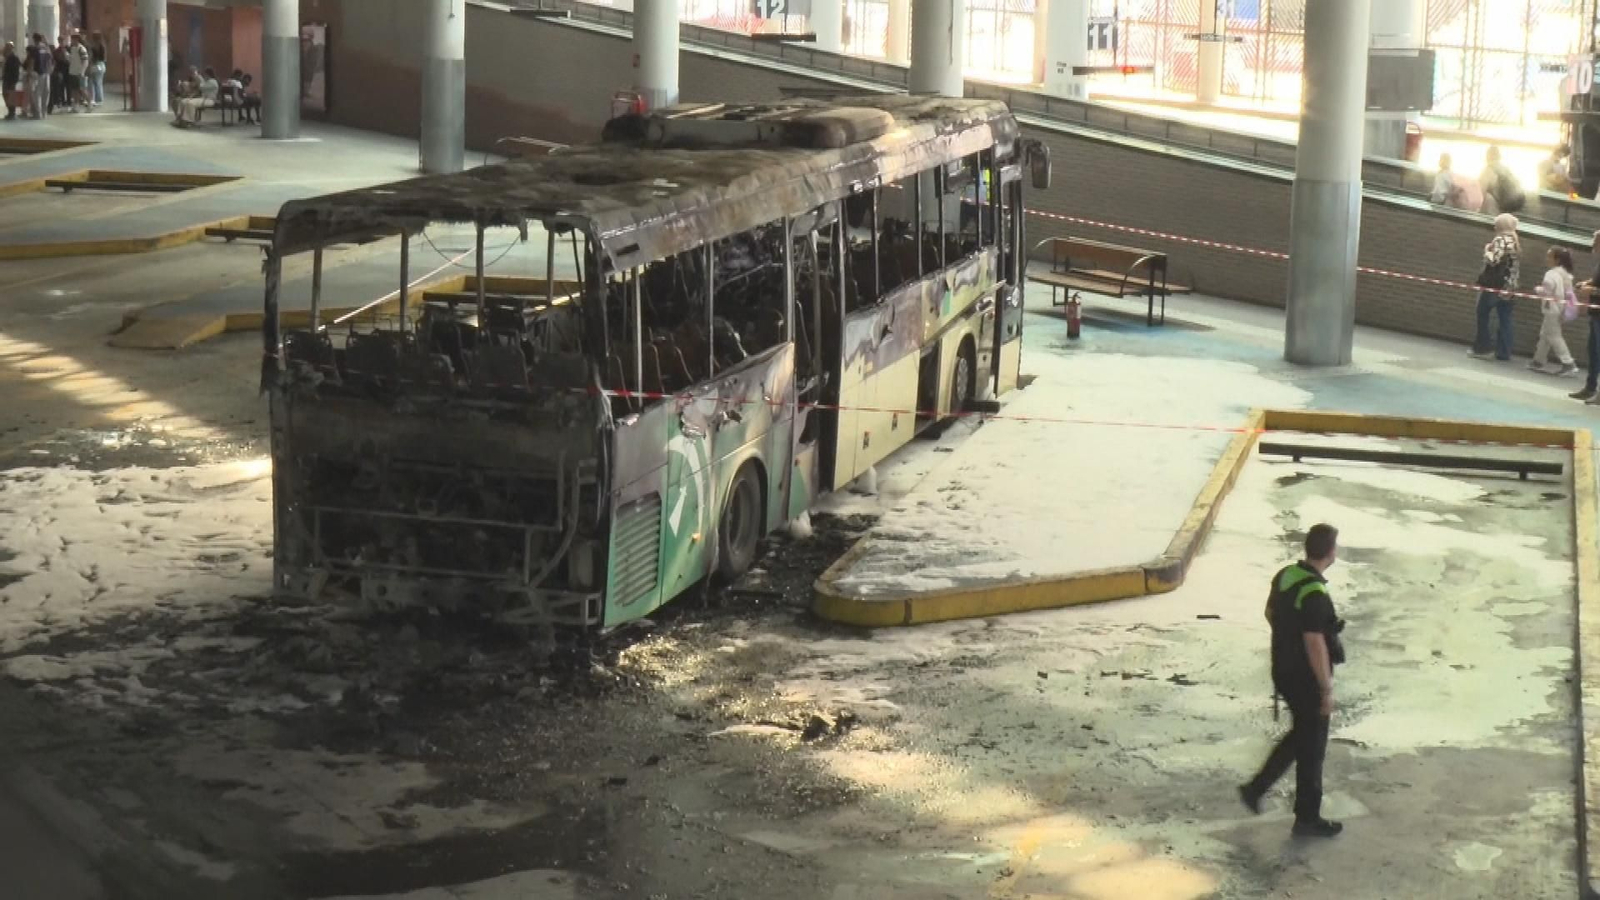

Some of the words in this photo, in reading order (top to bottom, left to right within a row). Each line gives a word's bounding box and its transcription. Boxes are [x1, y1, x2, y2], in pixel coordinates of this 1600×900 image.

[757, 0, 785, 19] 12
[1088, 23, 1113, 50] 11
[1567, 61, 1593, 94] 10
